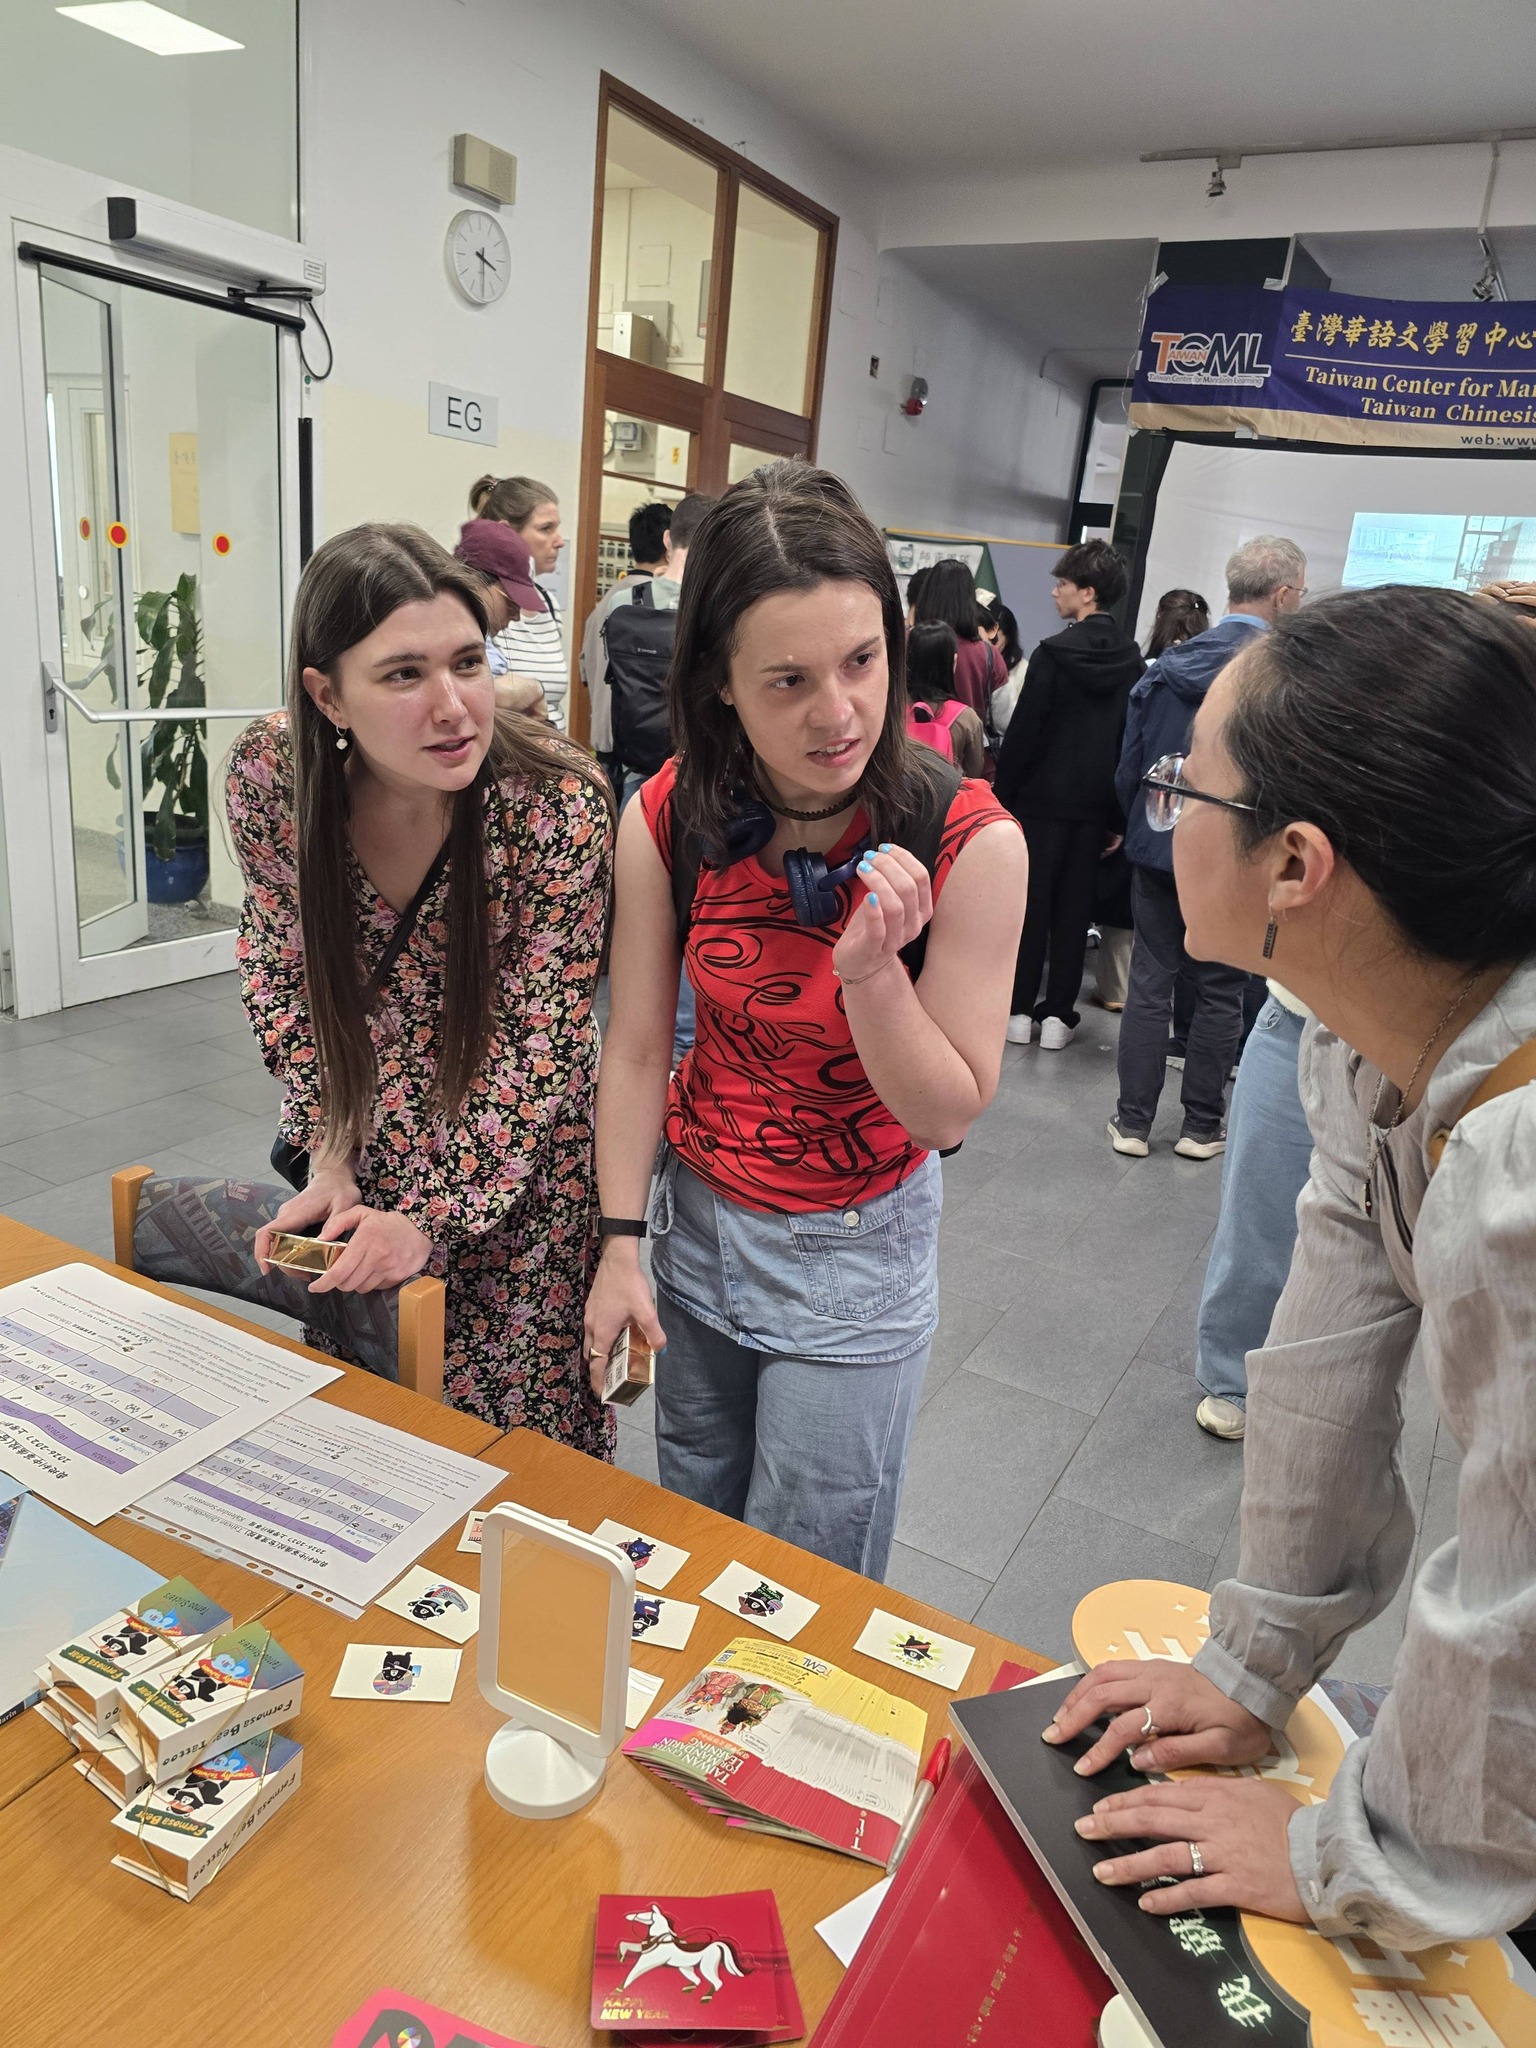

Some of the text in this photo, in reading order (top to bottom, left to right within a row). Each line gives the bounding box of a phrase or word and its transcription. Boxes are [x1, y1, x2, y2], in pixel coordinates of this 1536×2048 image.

[1290, 310, 1536, 356] 臺灣華語文學習中心
[1306, 366, 1378, 391] Taiwan
[1383, 374, 1455, 396] Center
[1458, 377, 1493, 397] for
[448, 396, 481, 432] EG
[1361, 397, 1436, 419] Taiwan
[161, 1496, 185, 1507] Schule
[187, 1495, 219, 1509] Semester
[215, 1507, 246, 1522] Kalender
[67, 1649, 124, 1679] Formosa Bear
[154, 1696, 188, 1724] Formosa
[244, 1700, 292, 1727] Formosa
[162, 1740, 208, 1766] Tattoo
[652, 1742, 729, 1786] TAIWAN CENTER
[659, 1736, 738, 1774] FOR MANDARIN
[688, 1737, 744, 1771] LEARNING
[221, 1771, 254, 1781] Friendly
[256, 1772, 296, 1815] Formosa
[134, 1810, 206, 1838] Formosa Bear
[192, 1842, 230, 1880] Tattoo
[601, 2009, 633, 2019] NEW
